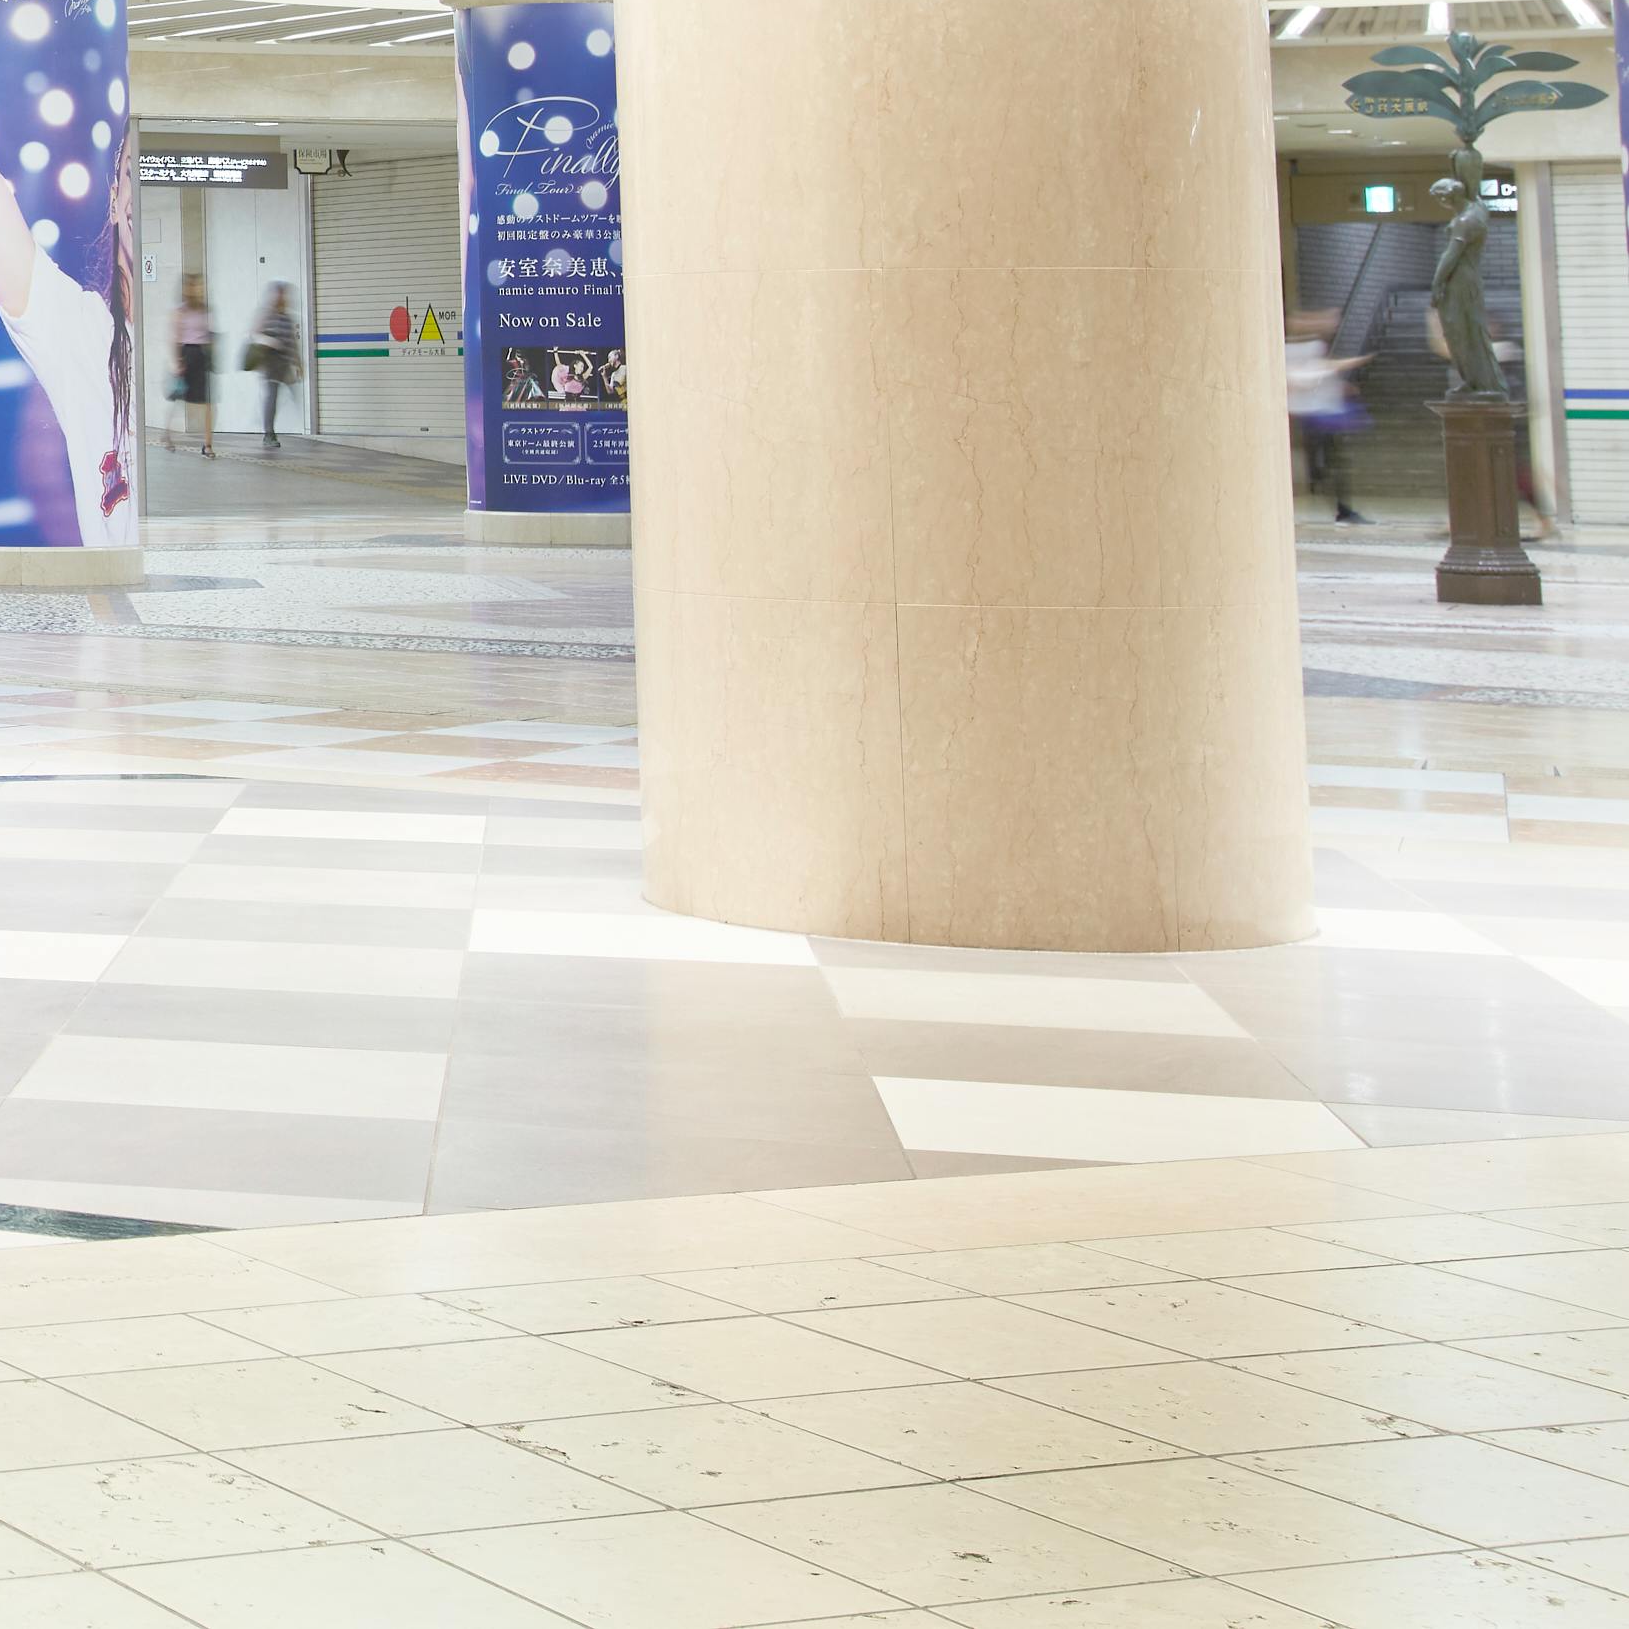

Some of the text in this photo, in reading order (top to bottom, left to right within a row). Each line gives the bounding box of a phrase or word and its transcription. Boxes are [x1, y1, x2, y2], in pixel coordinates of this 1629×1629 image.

[497, 257, 622, 279] 安室奈美恵、
[499, 284, 534, 296] namie
[538, 286, 579, 296] amuro
[584, 284, 613, 296] Final
[499, 312, 602, 328] Now on Sale
[503, 474, 528, 485] LIVE
